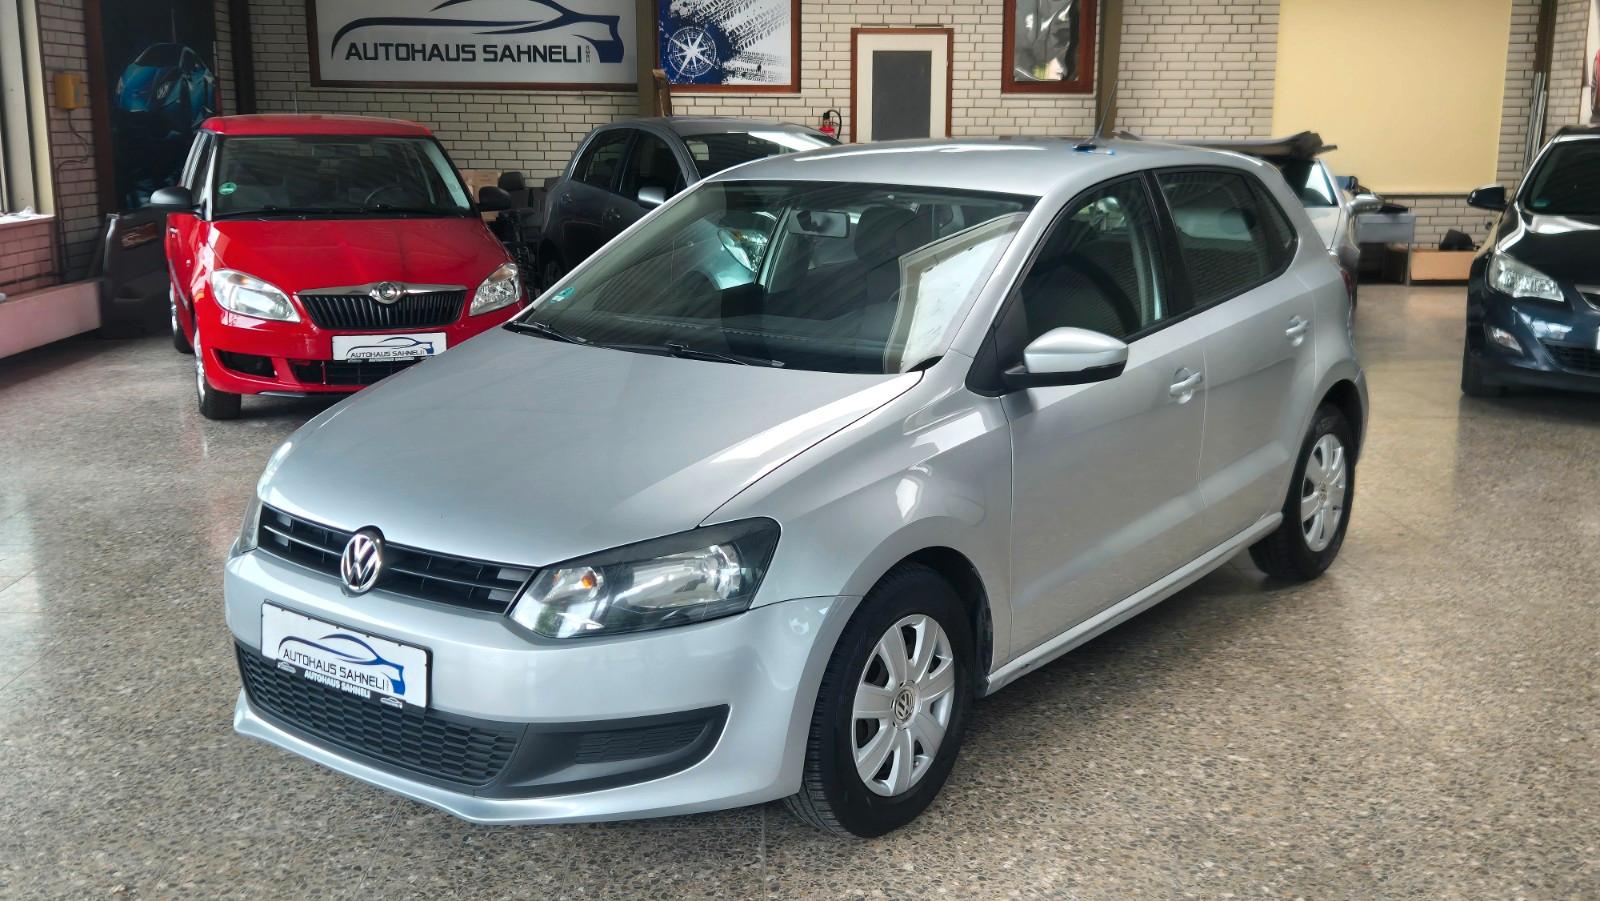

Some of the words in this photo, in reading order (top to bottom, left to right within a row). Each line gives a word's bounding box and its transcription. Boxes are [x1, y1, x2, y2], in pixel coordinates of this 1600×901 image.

[345, 42, 476, 62] AUTOHAUS
[482, 44, 582, 63] SAHNELI
[283, 648, 337, 675] AUTOHAUS
[339, 666, 385, 690] SAHNELI
[304, 670, 341, 689] AUTOHAUS
[341, 681, 371, 699] SAHNELI
